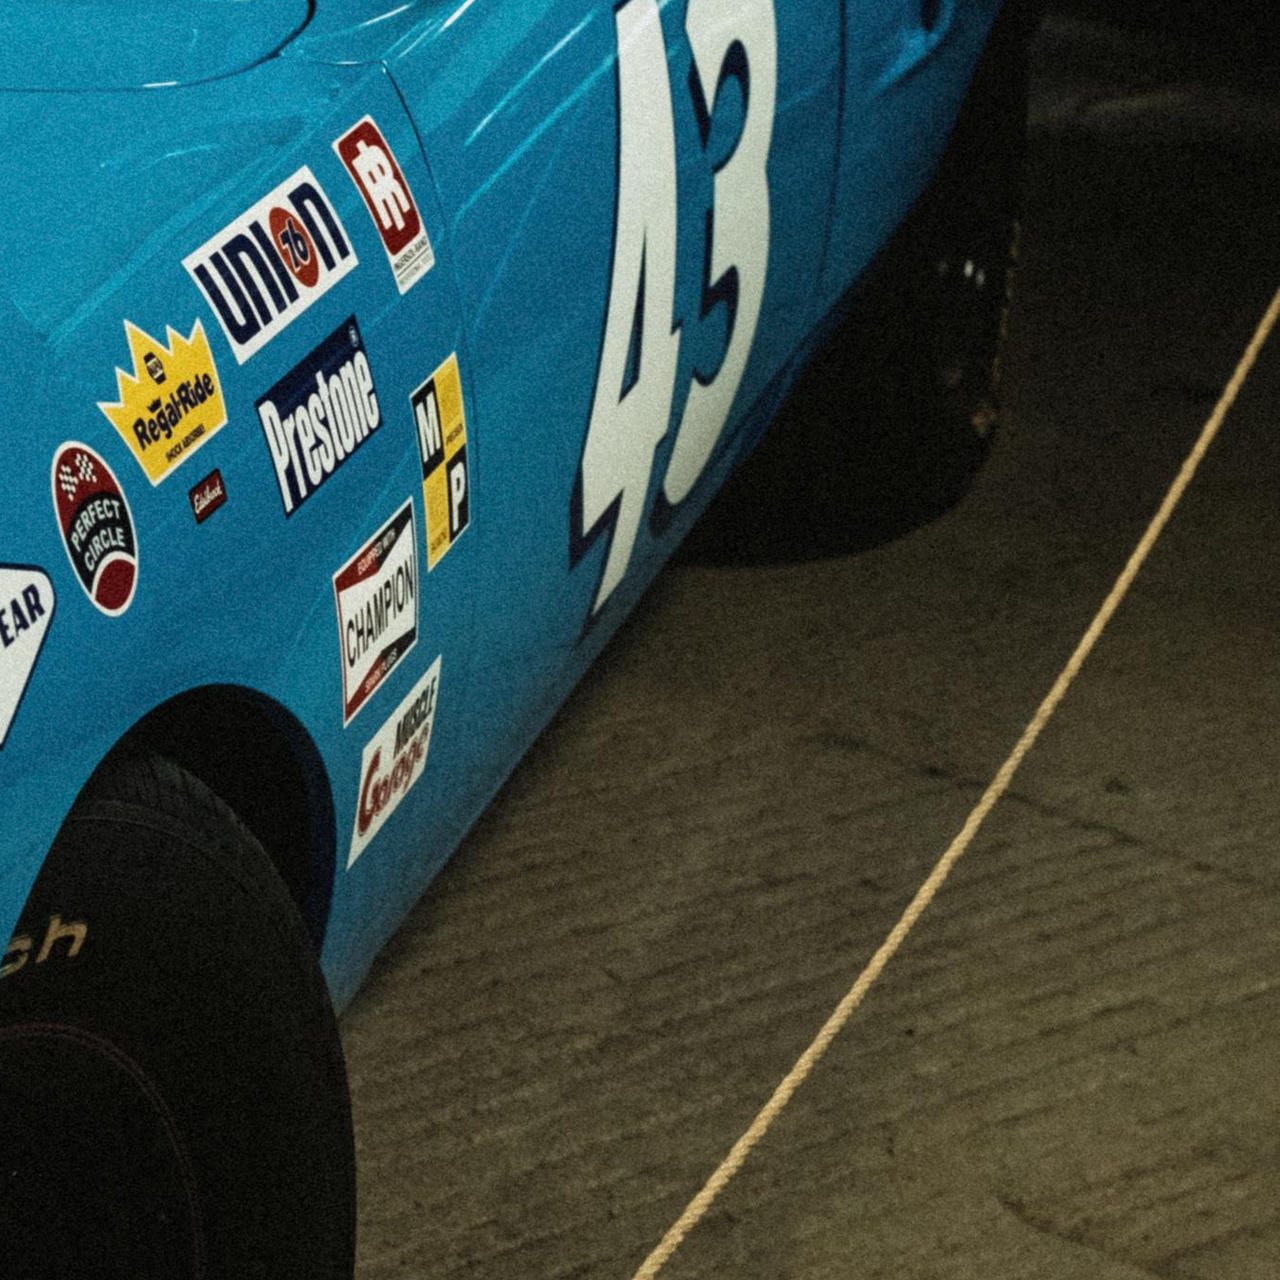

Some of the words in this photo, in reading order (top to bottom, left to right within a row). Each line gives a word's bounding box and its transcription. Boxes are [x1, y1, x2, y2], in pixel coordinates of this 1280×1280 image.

[257, 350, 380, 513] Prestone
[415, 390, 442, 464] M
[71, 498, 120, 553] PERFECT
[450, 461, 466, 533] P
[84, 526, 125, 572] CIRCLE
[346, 553, 414, 669] CHAMPION
